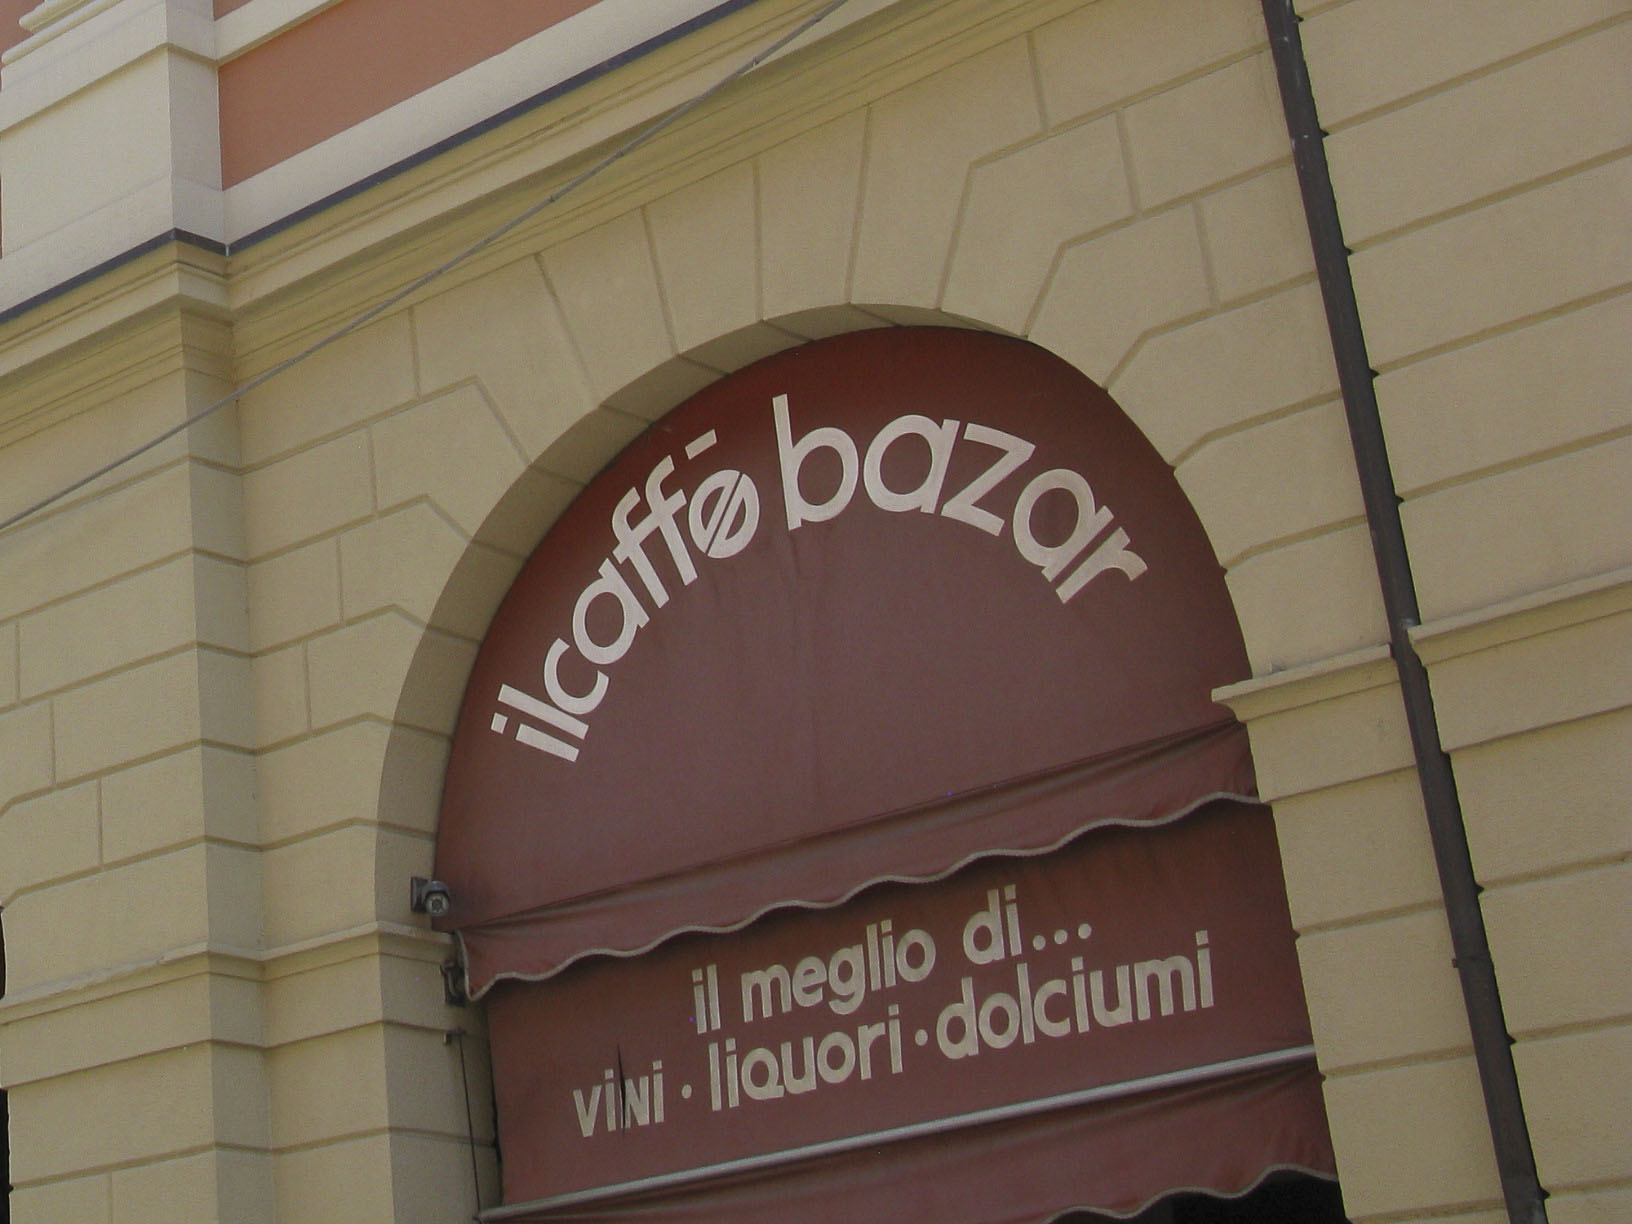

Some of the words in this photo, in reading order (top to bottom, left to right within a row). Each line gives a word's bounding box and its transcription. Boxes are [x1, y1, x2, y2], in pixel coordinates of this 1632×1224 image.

[772, 393, 1148, 604] bazar
[692, 963, 721, 1034] il
[741, 919, 936, 1023] meglio
[936, 930, 1214, 1060] dolciumi
